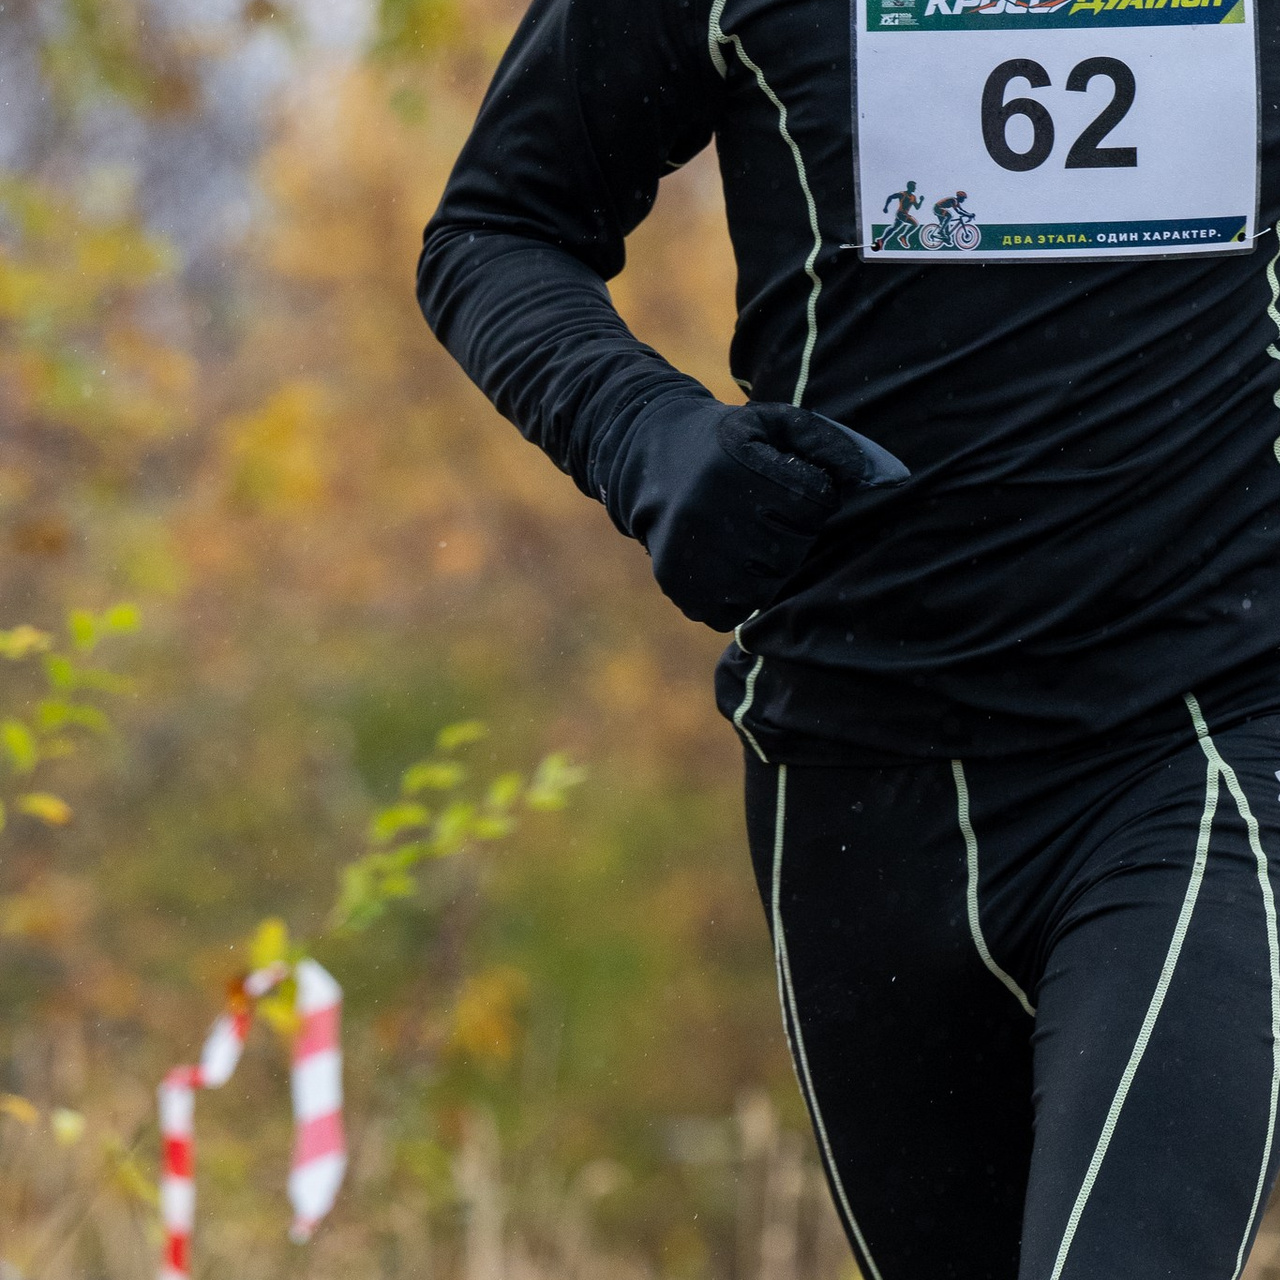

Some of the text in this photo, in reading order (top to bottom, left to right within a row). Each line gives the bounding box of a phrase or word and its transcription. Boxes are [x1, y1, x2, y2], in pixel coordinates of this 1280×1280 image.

[981, 56, 1138, 172] 62
[1002, 230, 1222, 246] ДВА ЭТАПА. ОДИН ХАРАКТЕР.
